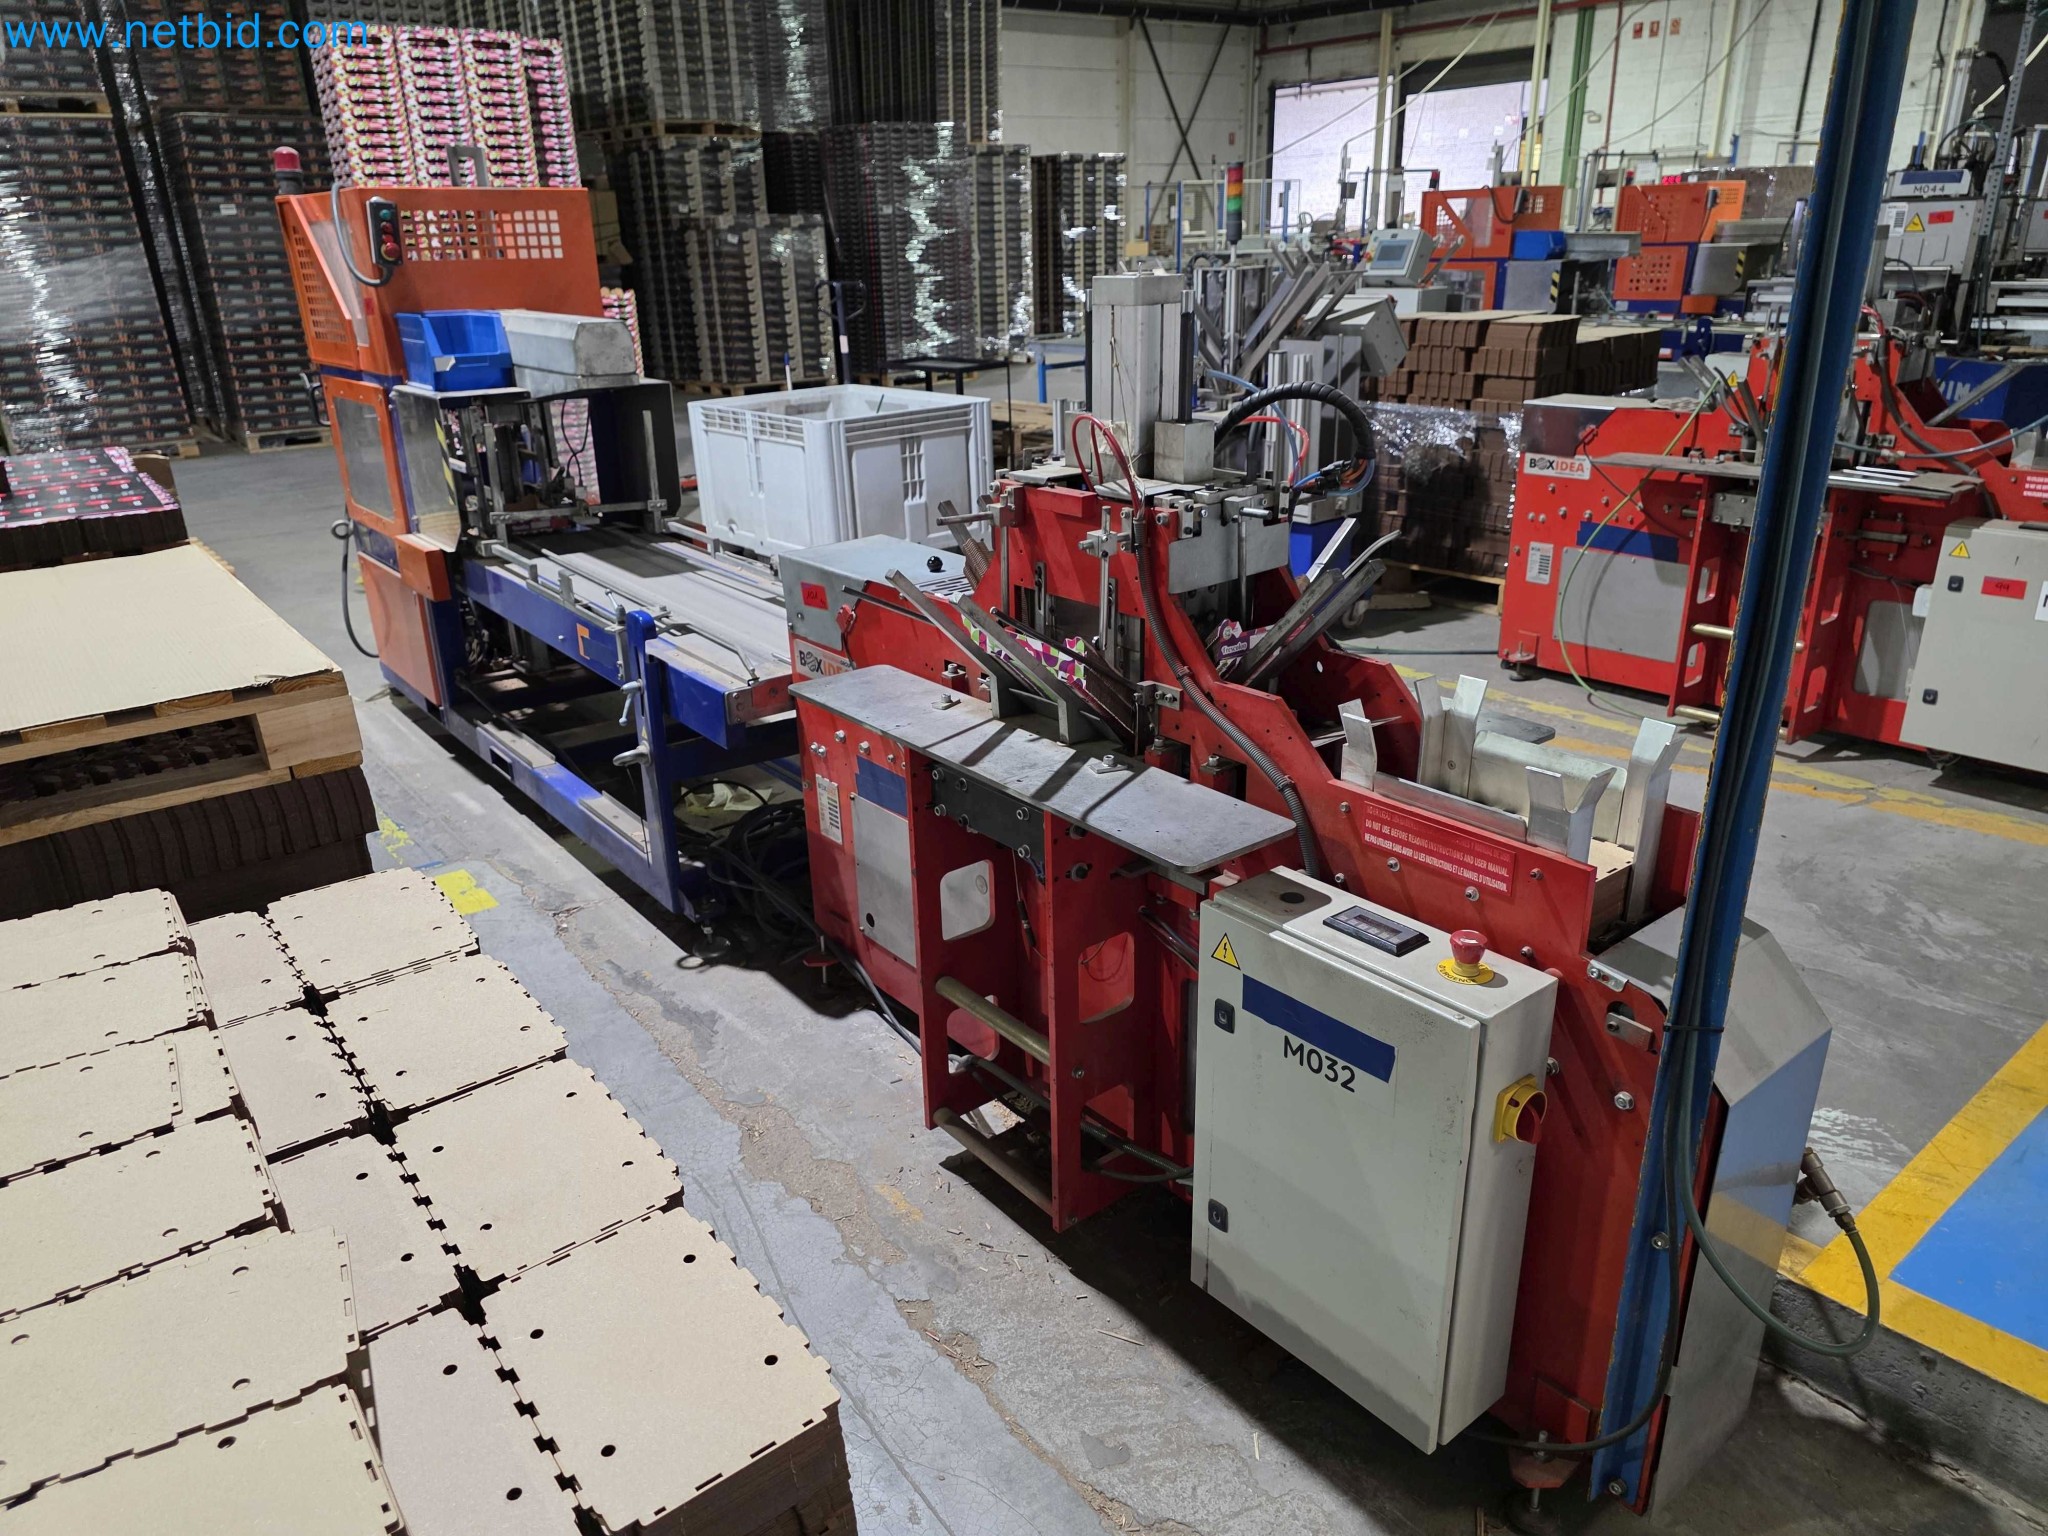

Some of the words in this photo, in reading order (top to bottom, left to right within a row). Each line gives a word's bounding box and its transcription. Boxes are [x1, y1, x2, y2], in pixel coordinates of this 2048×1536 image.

[1913, 184, 1945, 194] M044
[1529, 458, 1585, 473] BOXIDEA
[1366, 819, 1372, 828] DO
[1373, 821, 1381, 831] NOT
[1382, 825, 1391, 834] USE
[1391, 828, 1408, 841] BEFORE
[1409, 834, 1429, 848] READING
[1429, 841, 1463, 860] INSTRUCTIONS
[1464, 854, 1474, 864] AND
[1475, 858, 1487, 869] USER
[1393, 843, 1402, 853] SANS
[1426, 855, 1452, 871] INSTRUCTIONS
[1453, 865, 1458, 874] ET
[1458, 867, 1463, 876] LE
[1464, 869, 1479, 881] MANUEL
[1284, 1035, 1355, 1093] M032
